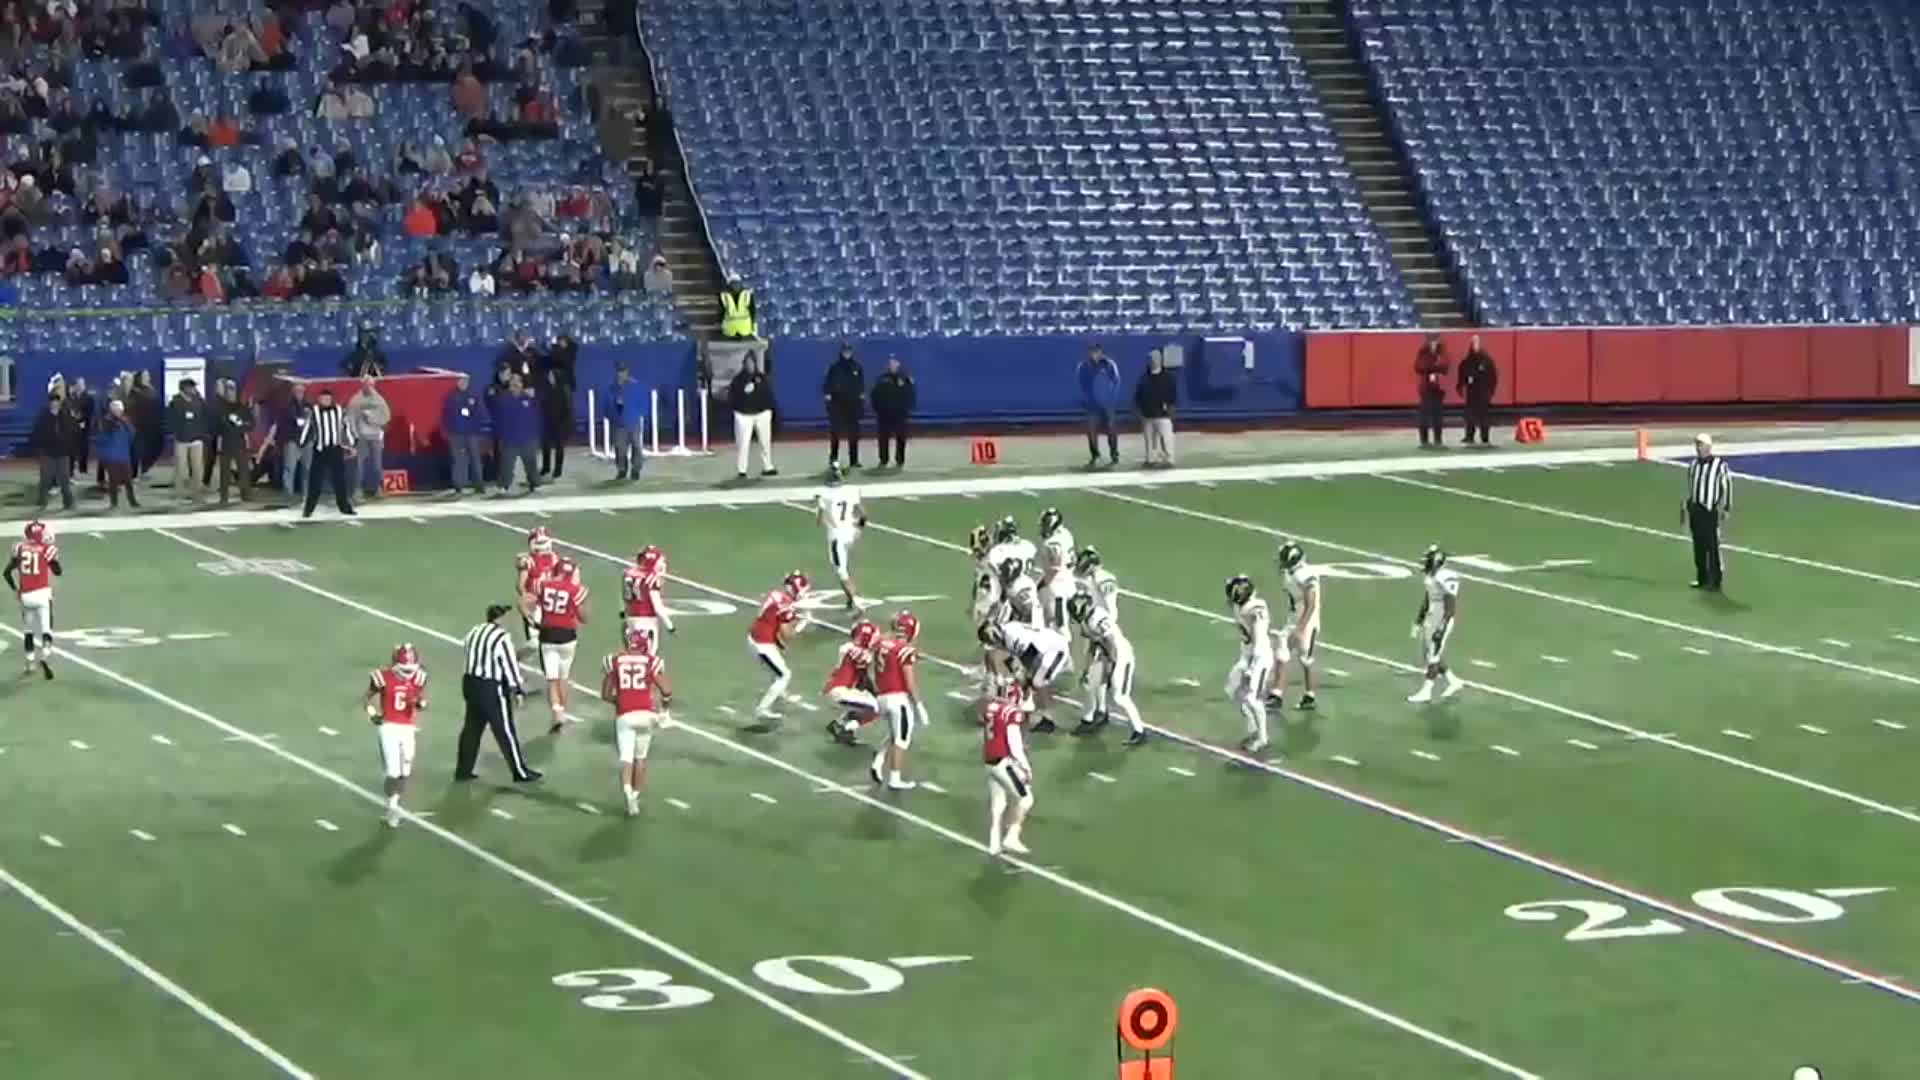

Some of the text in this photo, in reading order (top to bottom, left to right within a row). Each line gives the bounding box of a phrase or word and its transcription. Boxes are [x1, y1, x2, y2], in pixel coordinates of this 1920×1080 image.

[976, 441, 996, 462] 10
[383, 472, 406, 491] 20
[836, 500, 847, 521] 7
[21, 551, 40, 575] 21
[543, 587, 570, 615] 52
[619, 664, 646, 689] 62
[395, 691, 407, 711] 6
